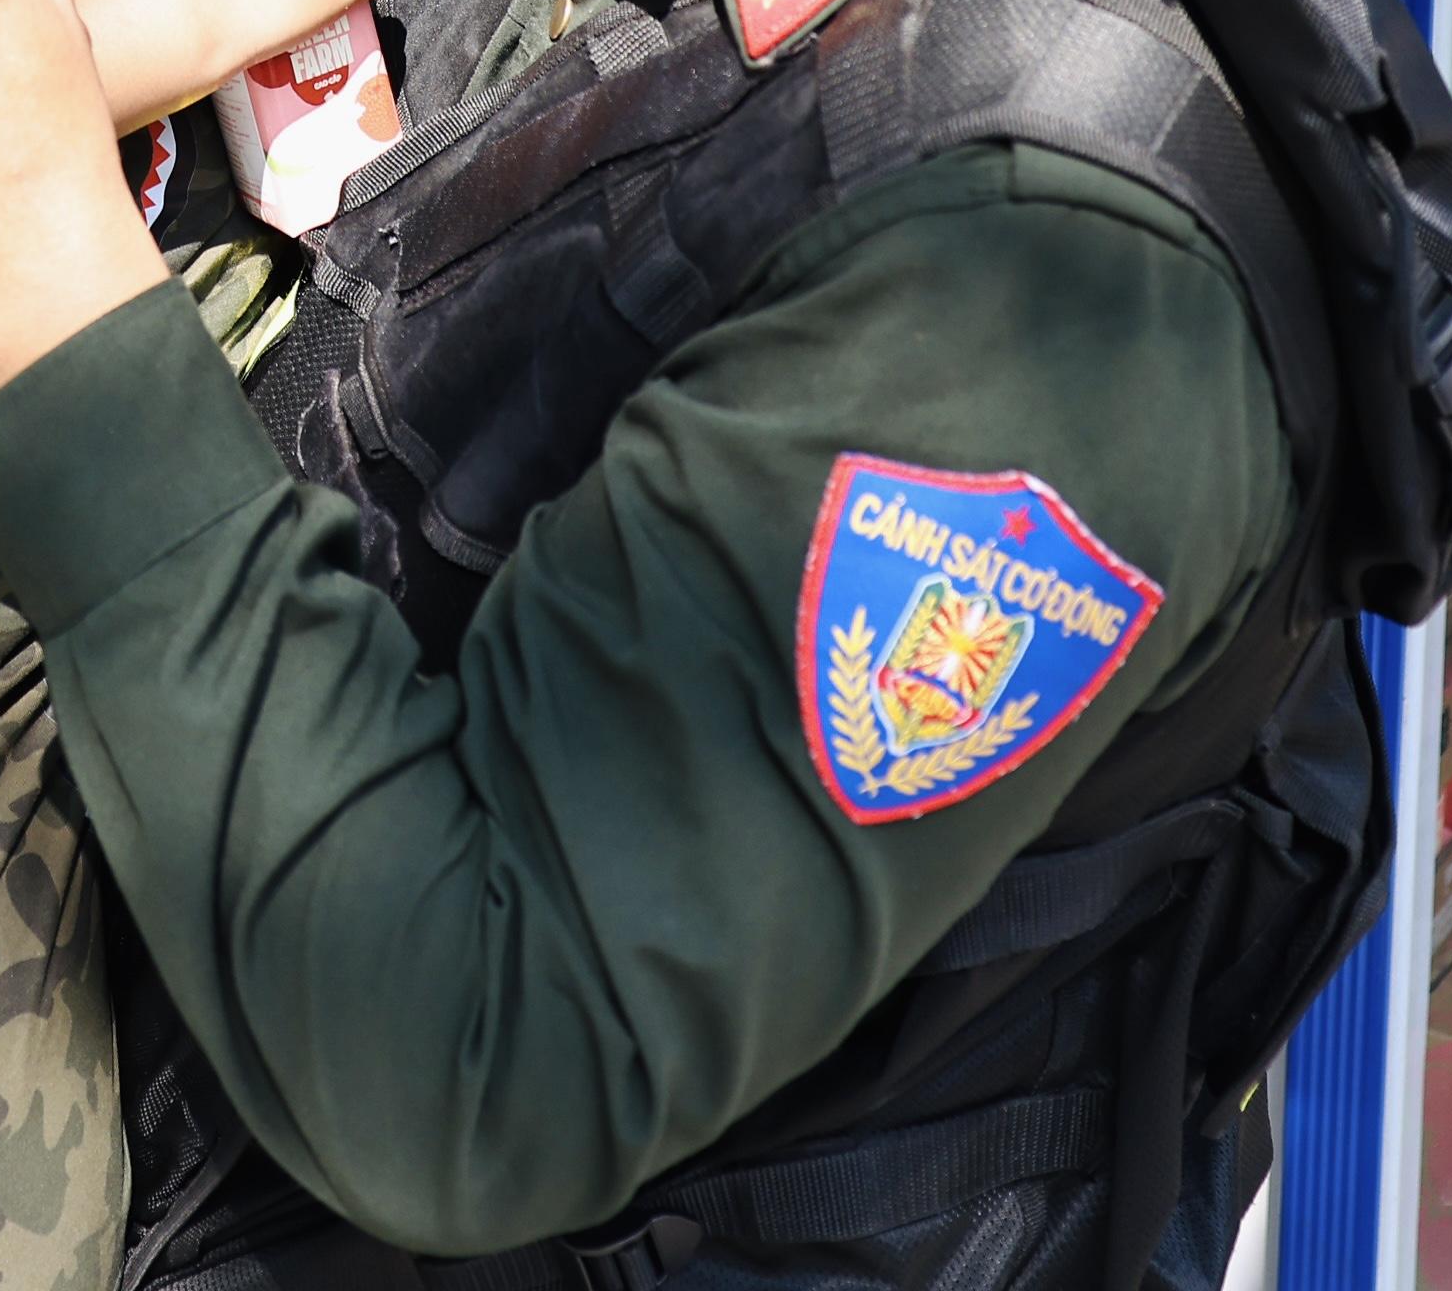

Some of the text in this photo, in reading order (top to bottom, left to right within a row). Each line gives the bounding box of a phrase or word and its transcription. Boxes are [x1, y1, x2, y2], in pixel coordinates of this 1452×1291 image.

[290, 34, 355, 85] FARM
[849, 491, 1128, 648] CẢNH SÁT CƠ ĐỘNG
